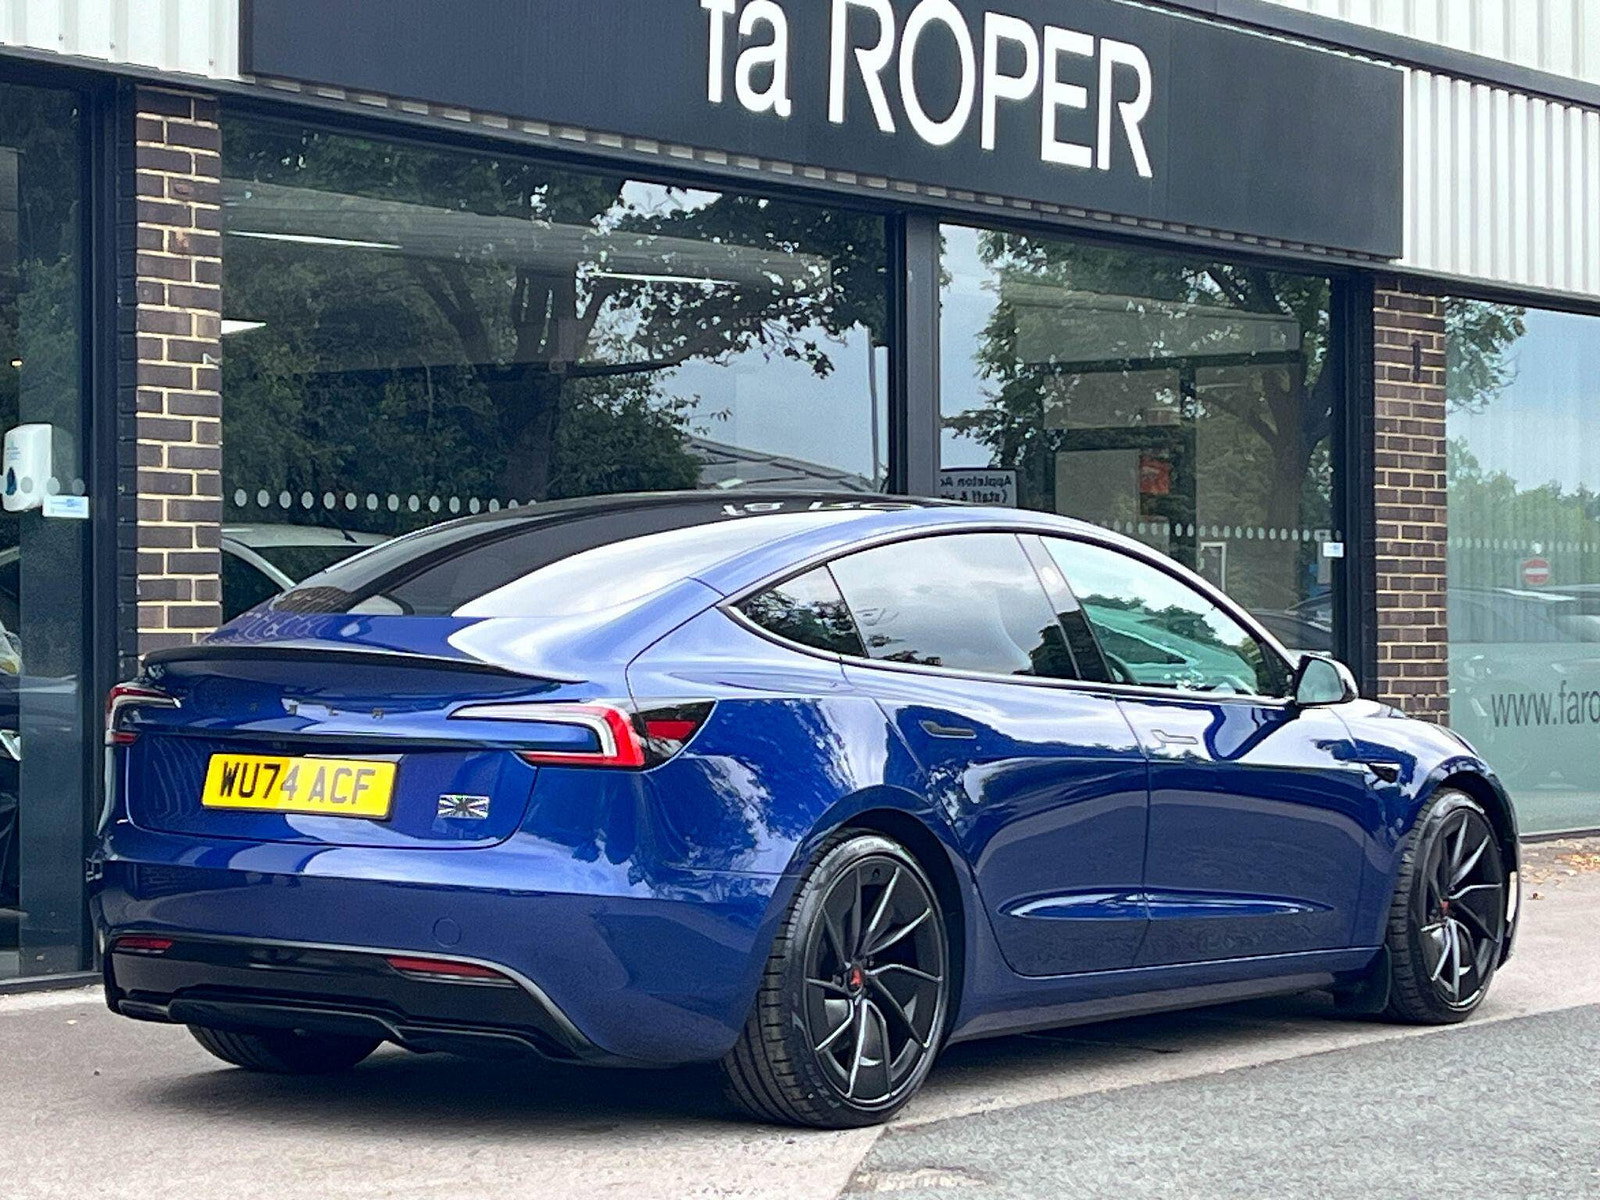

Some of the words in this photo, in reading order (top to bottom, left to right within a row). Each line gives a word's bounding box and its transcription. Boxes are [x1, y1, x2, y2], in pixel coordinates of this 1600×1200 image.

[700, 0, 792, 117] fa
[828, 0, 1153, 178] ROPER
[219, 761, 299, 801] WU74
[308, 766, 376, 805] ACF
